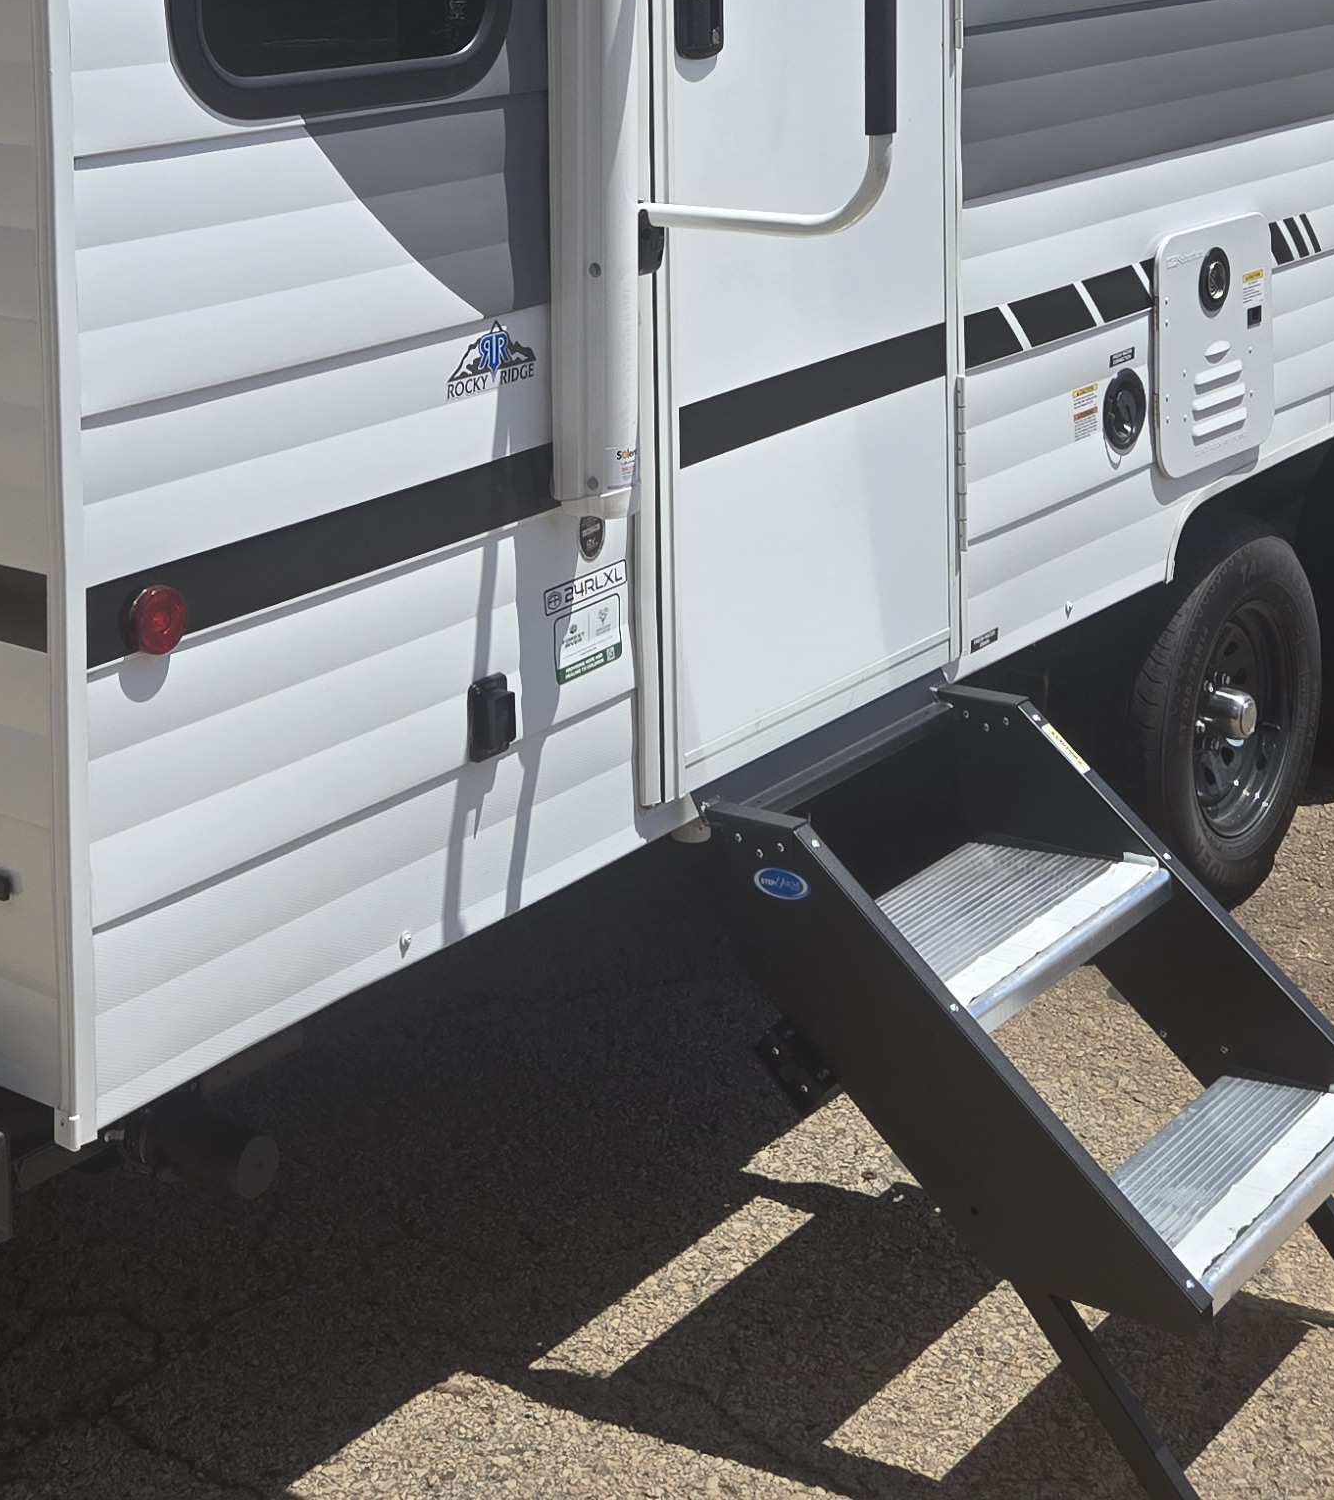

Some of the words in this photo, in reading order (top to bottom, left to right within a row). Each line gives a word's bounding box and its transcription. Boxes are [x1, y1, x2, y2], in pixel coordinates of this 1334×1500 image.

[447, 375, 489, 400] ROCKY
[499, 362, 535, 386] RIDGE
[563, 567, 623, 603] 24RLXL
